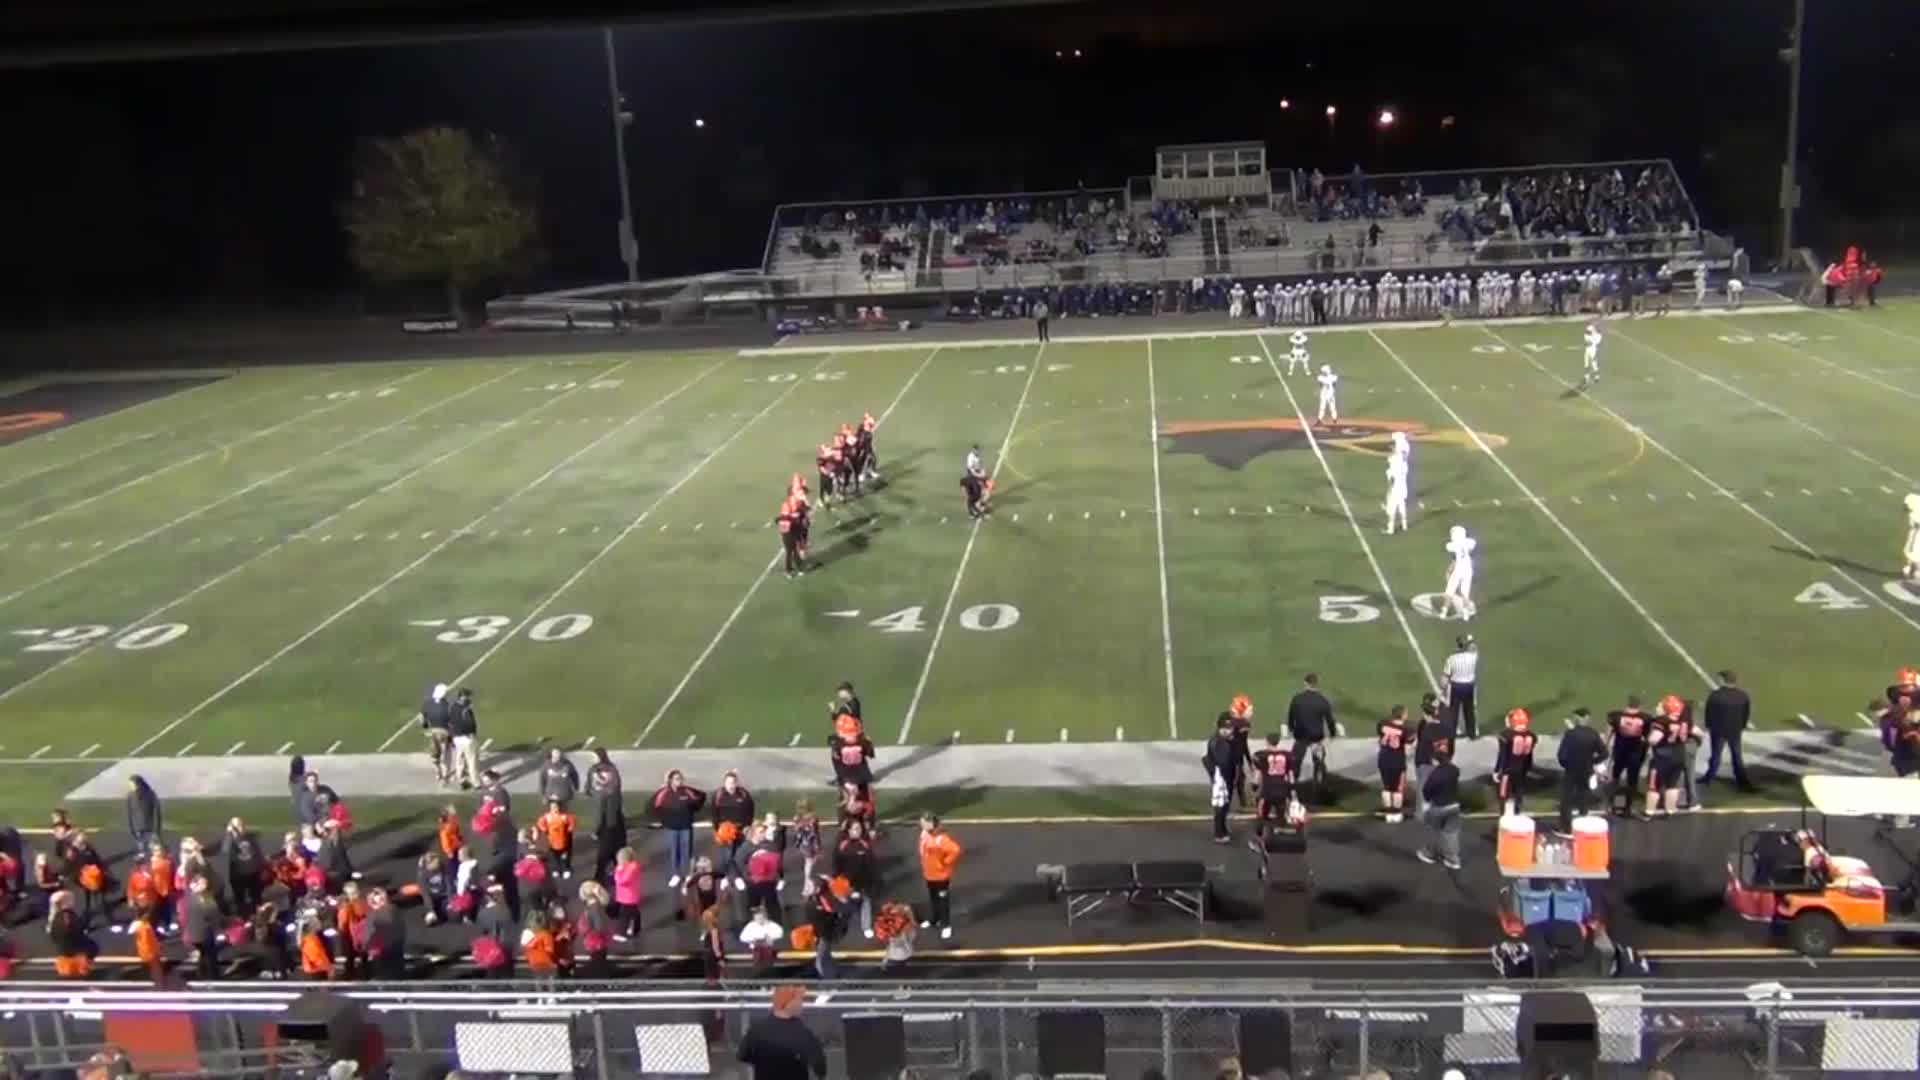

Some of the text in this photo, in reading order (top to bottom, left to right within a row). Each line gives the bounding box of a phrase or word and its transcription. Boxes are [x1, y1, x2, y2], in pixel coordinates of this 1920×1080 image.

[867, 603, 1020, 632] 40
[1318, 594, 1477, 623] 50
[21, 624, 189, 653] 20
[435, 613, 594, 642] 30
